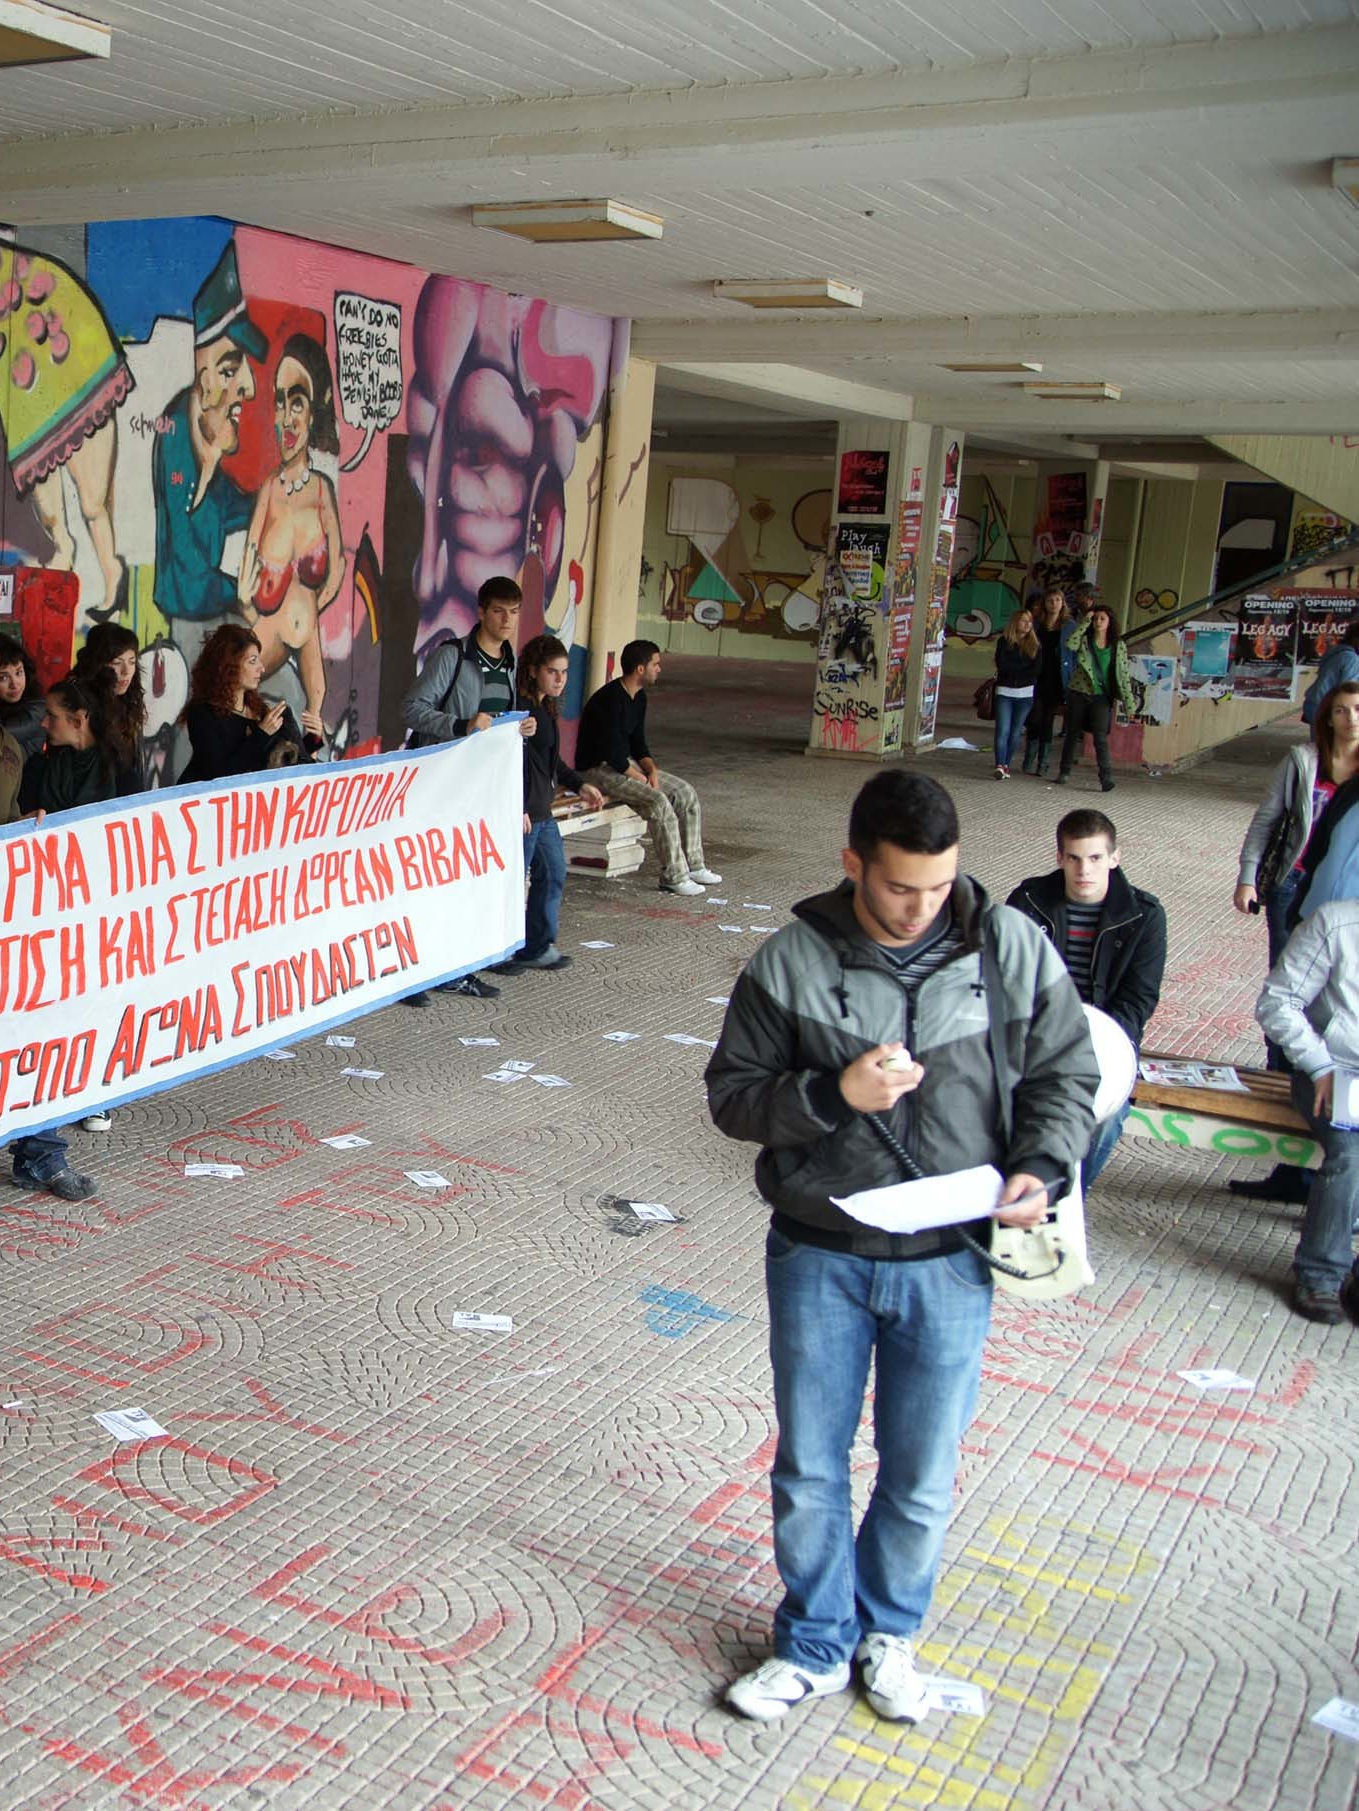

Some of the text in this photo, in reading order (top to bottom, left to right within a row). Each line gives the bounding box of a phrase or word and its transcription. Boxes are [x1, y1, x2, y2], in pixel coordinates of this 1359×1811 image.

[368, 307, 383, 328] DO
[385, 311, 399, 329] NO
[338, 323, 388, 349] FREEBIES
[342, 350, 374, 371] HONEY
[368, 367, 380, 389] MY
[842, 529, 868, 545] Play
[1244, 600, 1295, 610] OPENING
[1304, 599, 1358, 609] OPENING
[1241, 622, 1293, 637] LEGACY
[1301, 620, 1350, 635] LEGAC
[104, 811, 176, 897] ΠΙΑ
[179, 786, 280, 875] ΣΤΗΝ
[99, 906, 156, 988] ΚΑΙ
[164, 865, 289, 965] ΣΤΕΓΑΣΗ
[294, 841, 394, 921] ΔΩΡΕΑΝ
[395, 818, 506, 892] ΒΙΒΛΙΑ
[101, 983, 223, 1086] ΑΓΩΝΑ
[230, 915, 419, 1037] ΣΠΟΥΔΑΣΤΩΝ
